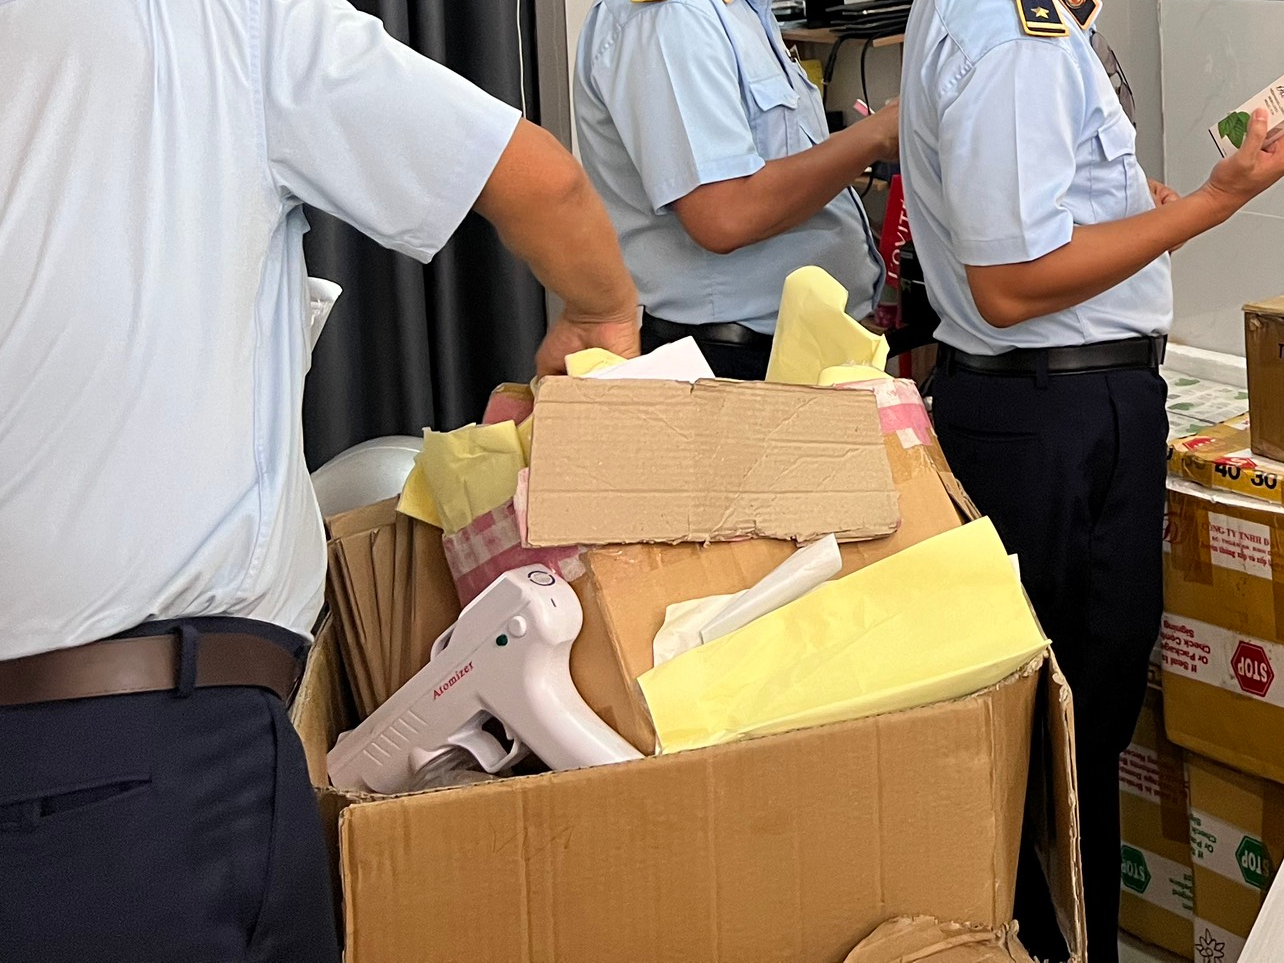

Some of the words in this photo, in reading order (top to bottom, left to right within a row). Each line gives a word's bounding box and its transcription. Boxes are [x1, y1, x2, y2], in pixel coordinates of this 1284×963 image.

[1214, 464, 1242, 481] 40
[1250, 470, 1278, 490] 30
[432, 660, 475, 701] Atomizer
[1236, 656, 1269, 683] STOP
[1120, 859, 1146, 883] STOP
[1240, 849, 1271, 878] STOP
